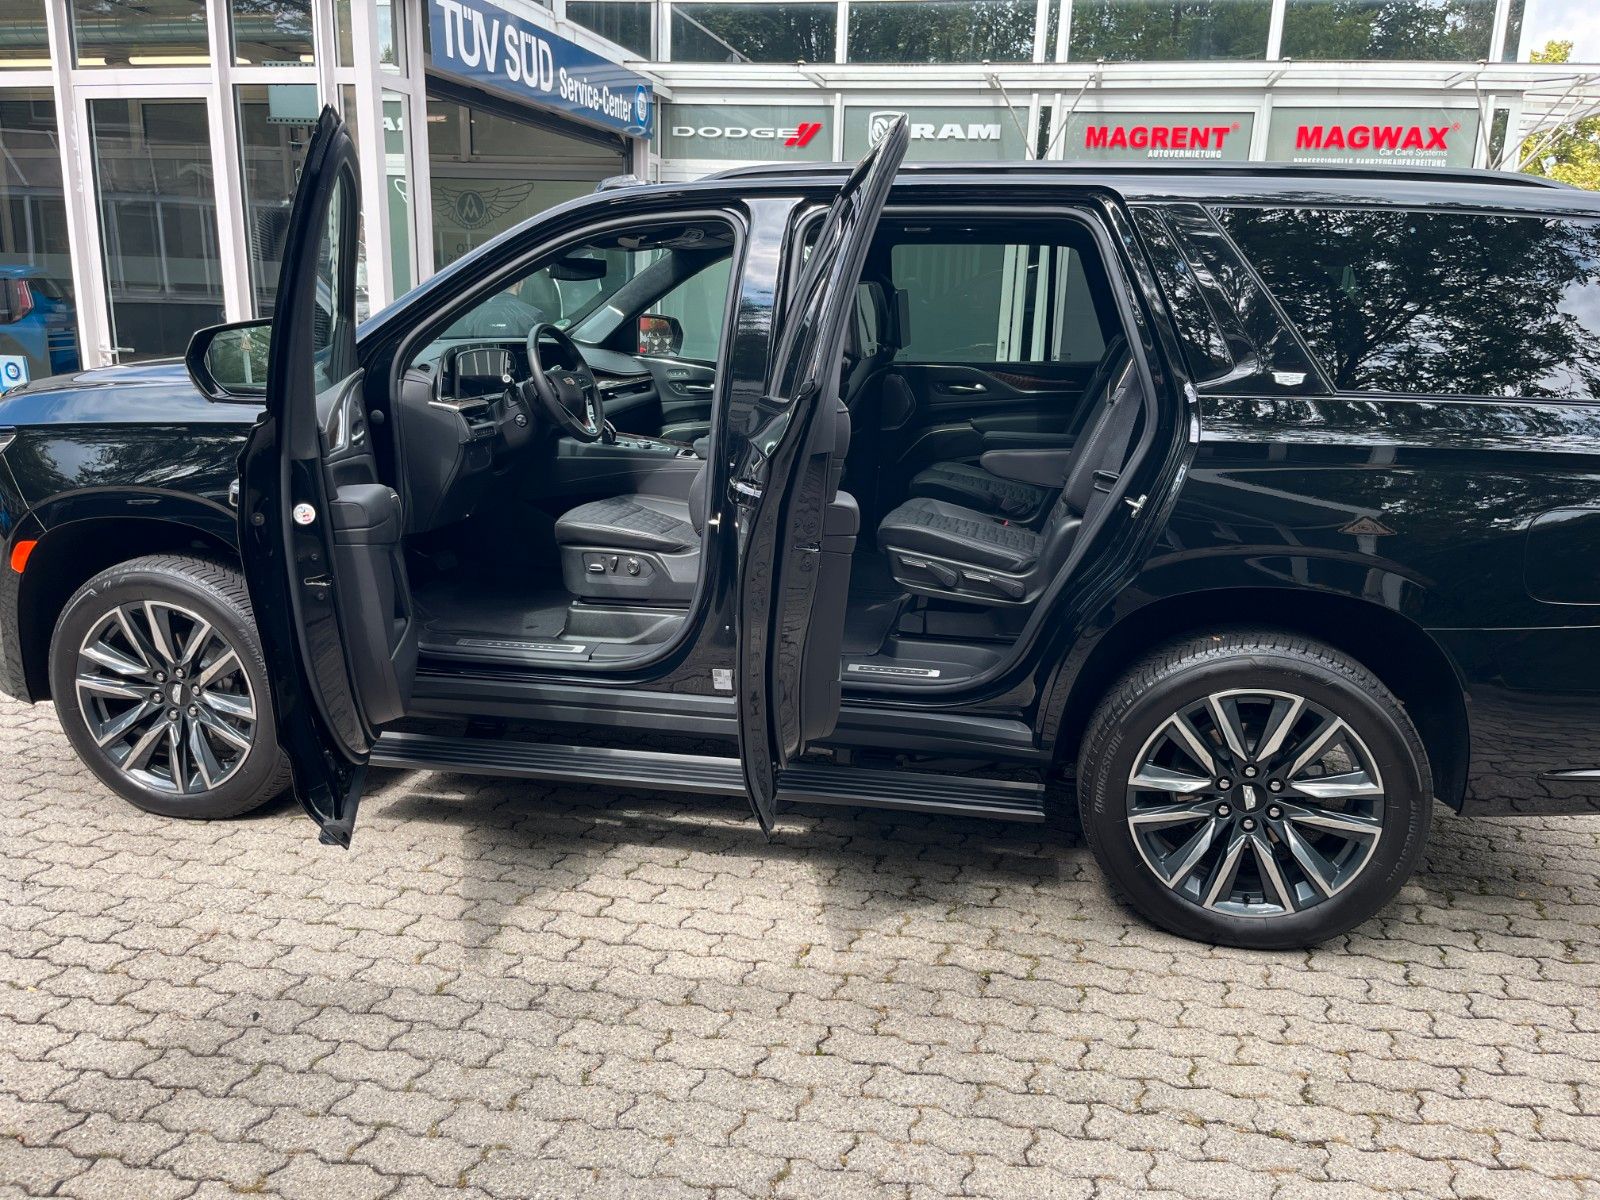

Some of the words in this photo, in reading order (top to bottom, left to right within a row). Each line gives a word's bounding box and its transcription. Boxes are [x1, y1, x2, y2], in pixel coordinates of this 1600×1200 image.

[436, 0, 499, 72] TÜV
[504, 24, 554, 92] SÜD
[559, 67, 632, 122] Service-Center
[672, 126, 799, 139] DODGE
[910, 123, 1001, 140] RAM
[1147, 150, 1222, 159] AUTOVERMIETUNG
[1395, 149, 1414, 157] Care
[1415, 149, 1448, 158] Systems
